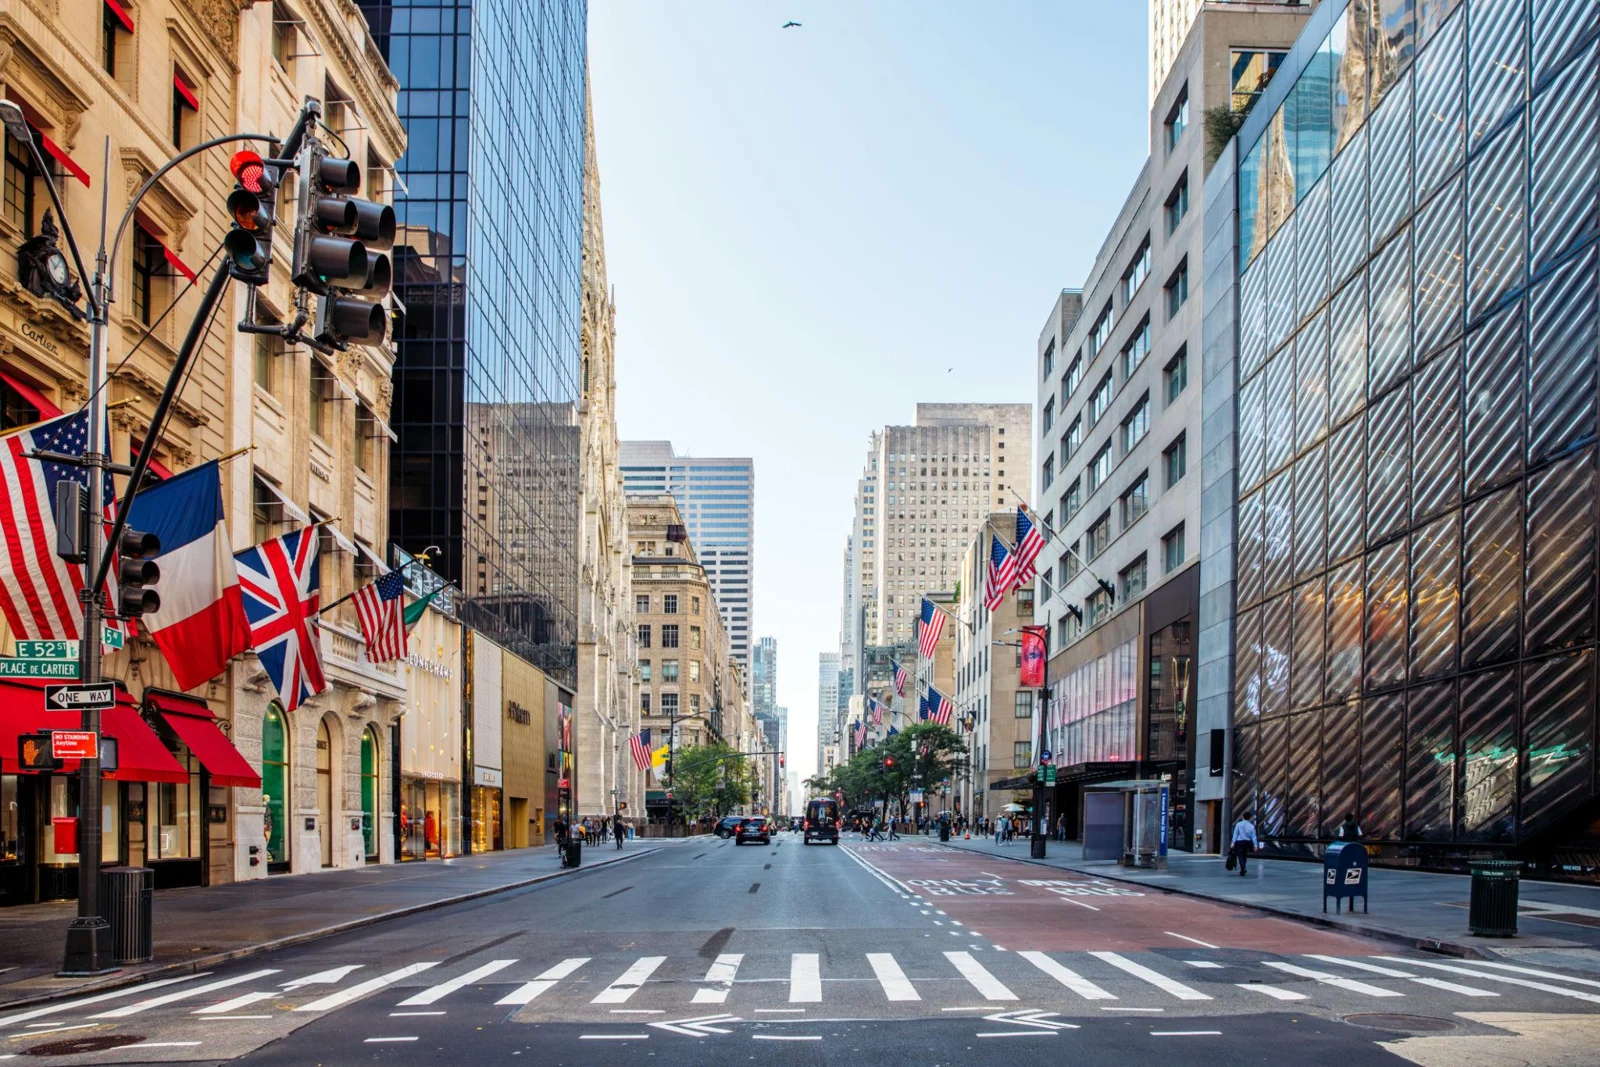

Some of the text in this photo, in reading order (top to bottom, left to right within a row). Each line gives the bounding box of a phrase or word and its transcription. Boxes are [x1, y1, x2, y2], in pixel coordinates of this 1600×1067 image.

[21, 323, 59, 356] Cartier
[106, 629, 112, 644] 5
[18, 642, 67, 657] E 52 ST
[0, 662, 27, 674] PLACE
[41, 663, 75, 675] CARTIER
[409, 651, 453, 681] LONGCHAMP
[57, 691, 109, 703] ONE WAY
[907, 879, 1003, 887] ONLY
[1017, 879, 1115, 887] ONLY
[924, 886, 1015, 896] BUS
[1043, 887, 1146, 897] BUS
